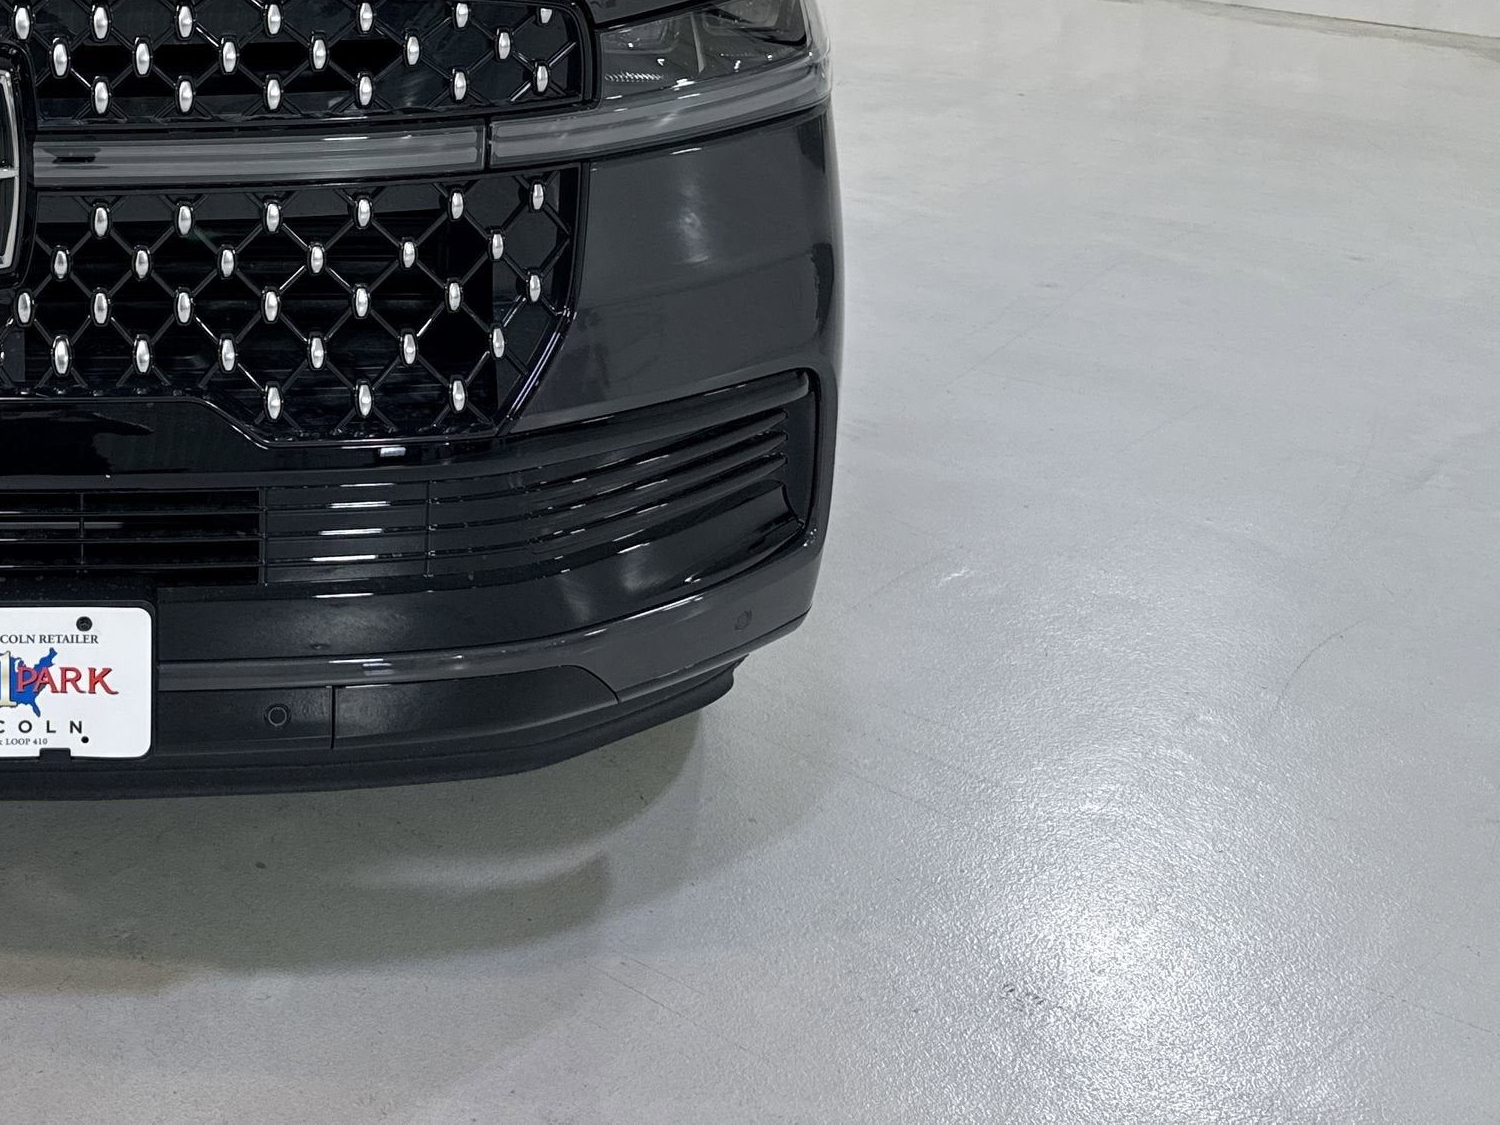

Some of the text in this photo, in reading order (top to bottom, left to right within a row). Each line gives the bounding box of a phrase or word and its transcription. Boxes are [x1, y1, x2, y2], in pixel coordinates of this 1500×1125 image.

[39, 634, 99, 645] RETAILER
[15, 667, 119, 695] PARK
[5, 737, 30, 746] LOOP
[32, 737, 48, 746] 410
